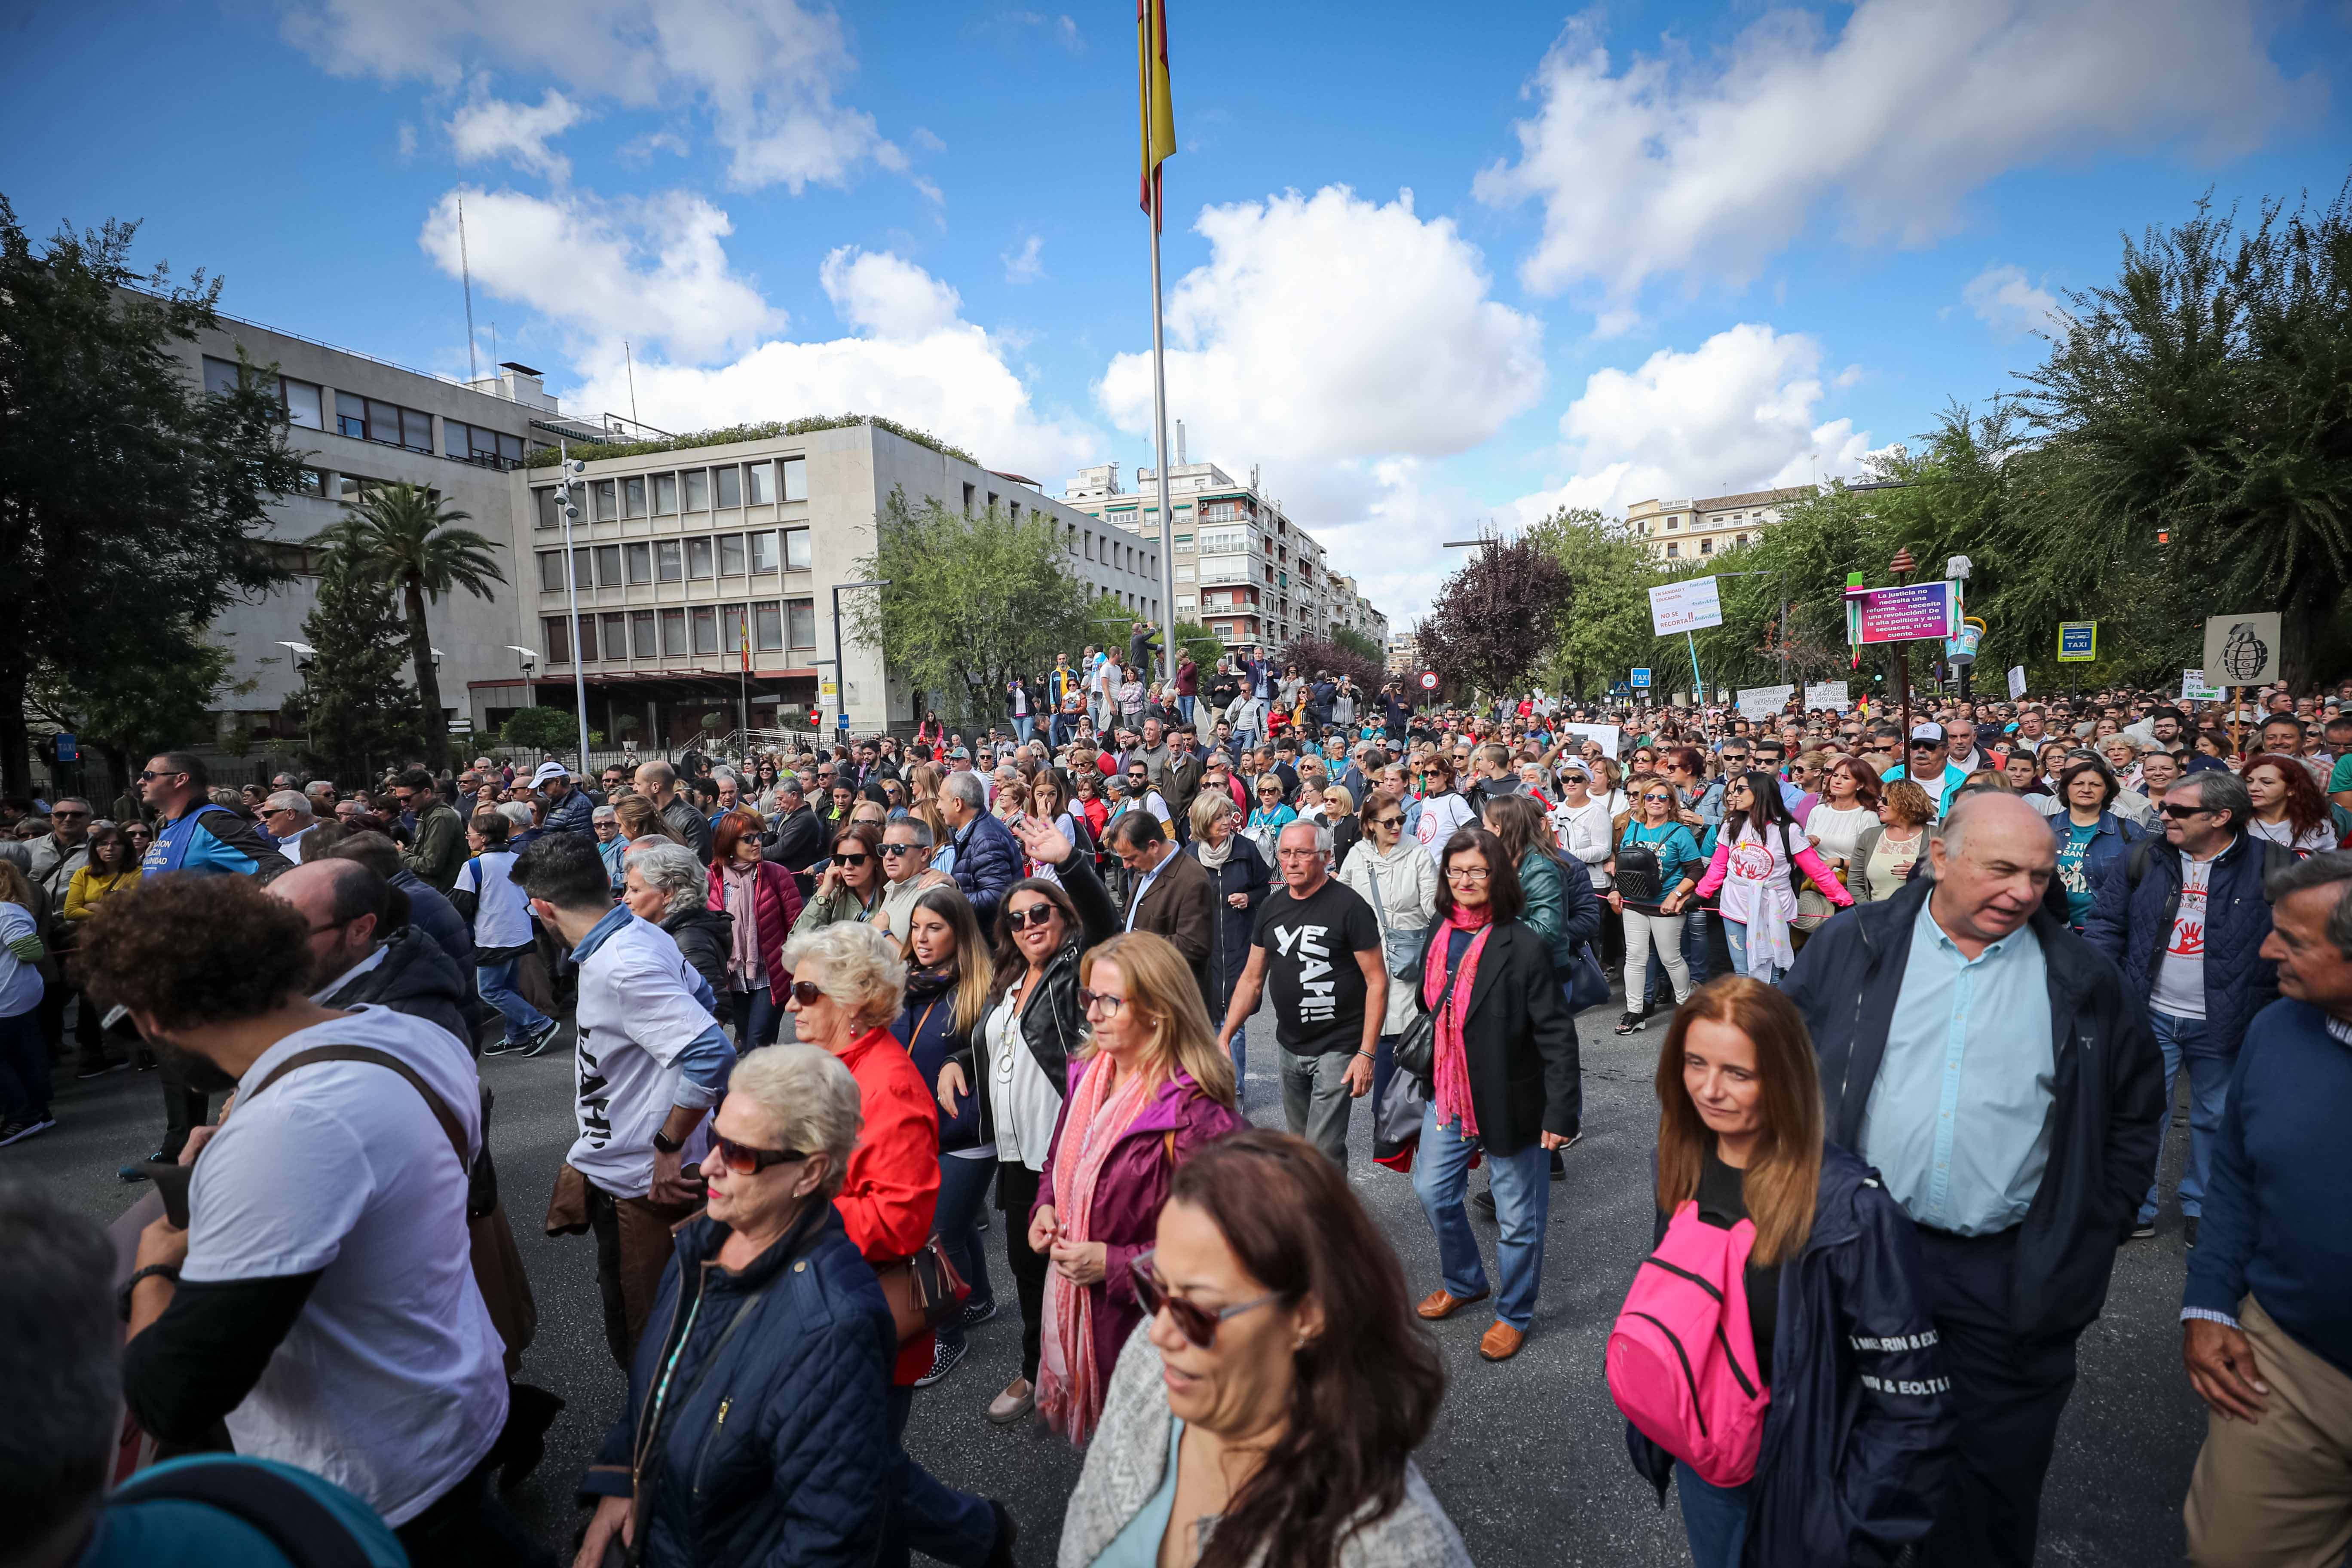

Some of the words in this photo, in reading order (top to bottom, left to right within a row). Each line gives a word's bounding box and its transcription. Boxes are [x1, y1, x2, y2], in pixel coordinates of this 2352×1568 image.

[1662, 588, 1681, 596] SANIDAD
[1888, 590, 1916, 599] justicia
[1883, 609, 1926, 618] revolución!!
[1891, 616, 1919, 625] política
[58, 743, 76, 752] TAXI
[1909, 1335, 1920, 1349] &
[1884, 1379, 1896, 1393] &
